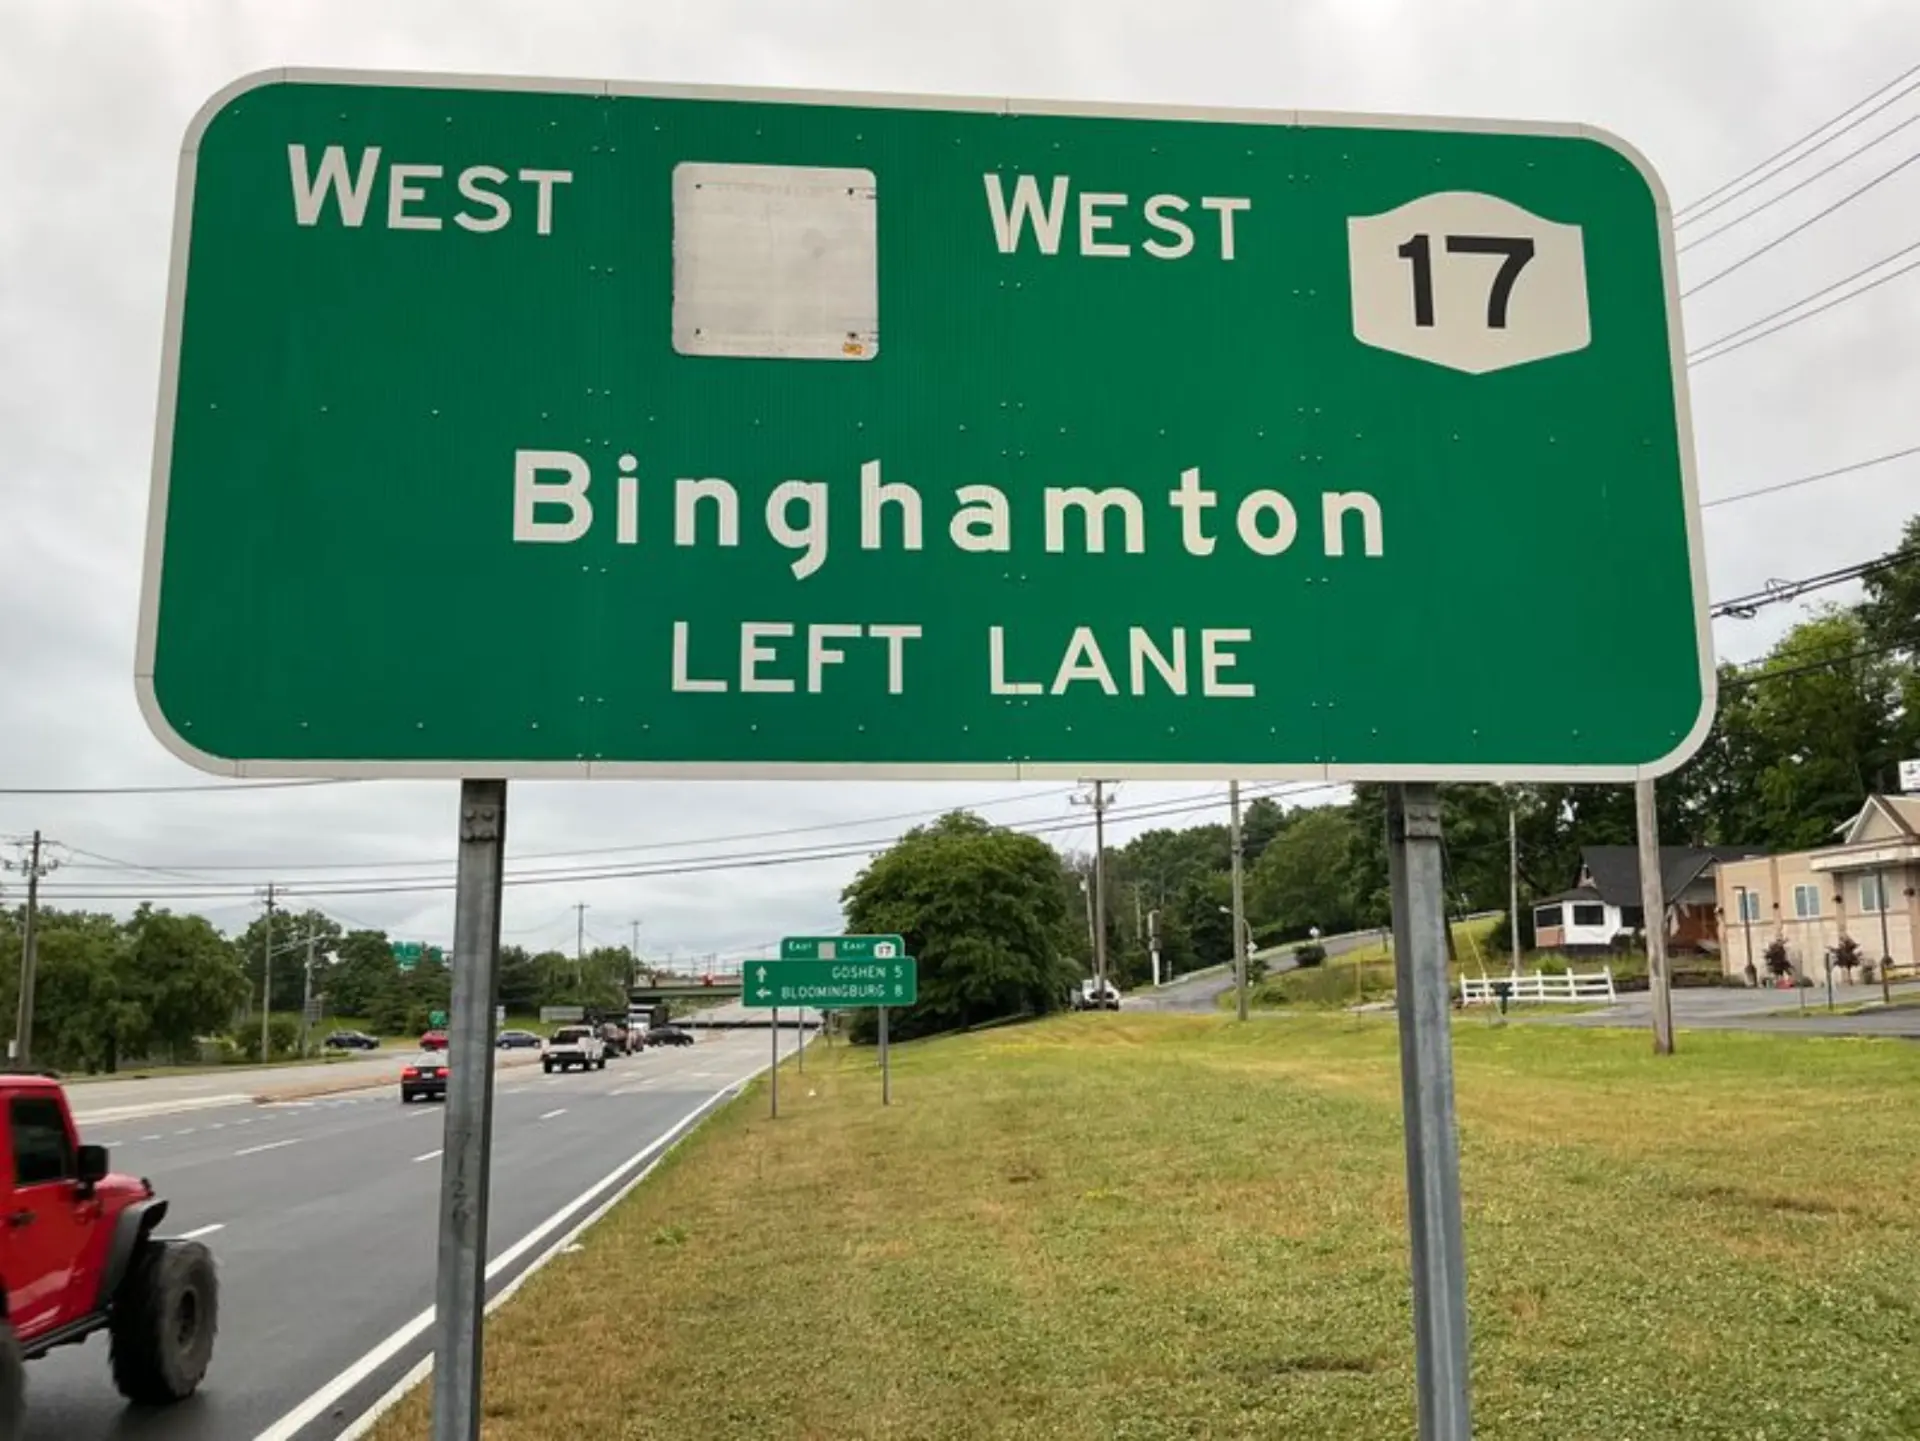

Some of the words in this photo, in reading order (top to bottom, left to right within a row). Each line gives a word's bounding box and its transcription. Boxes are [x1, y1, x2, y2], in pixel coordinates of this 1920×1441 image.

[289, 145, 573, 234] WEST
[984, 174, 1251, 260] WEST
[1398, 234, 1535, 329] 17
[513, 450, 1384, 580] Binghamton
[672, 621, 922, 694] LEFT
[990, 626, 1255, 697] LANE
[781, 985, 886, 999] BLOOMINGBURG
[831, 966, 887, 979] GOSHEN
[894, 966, 904, 979] 5
